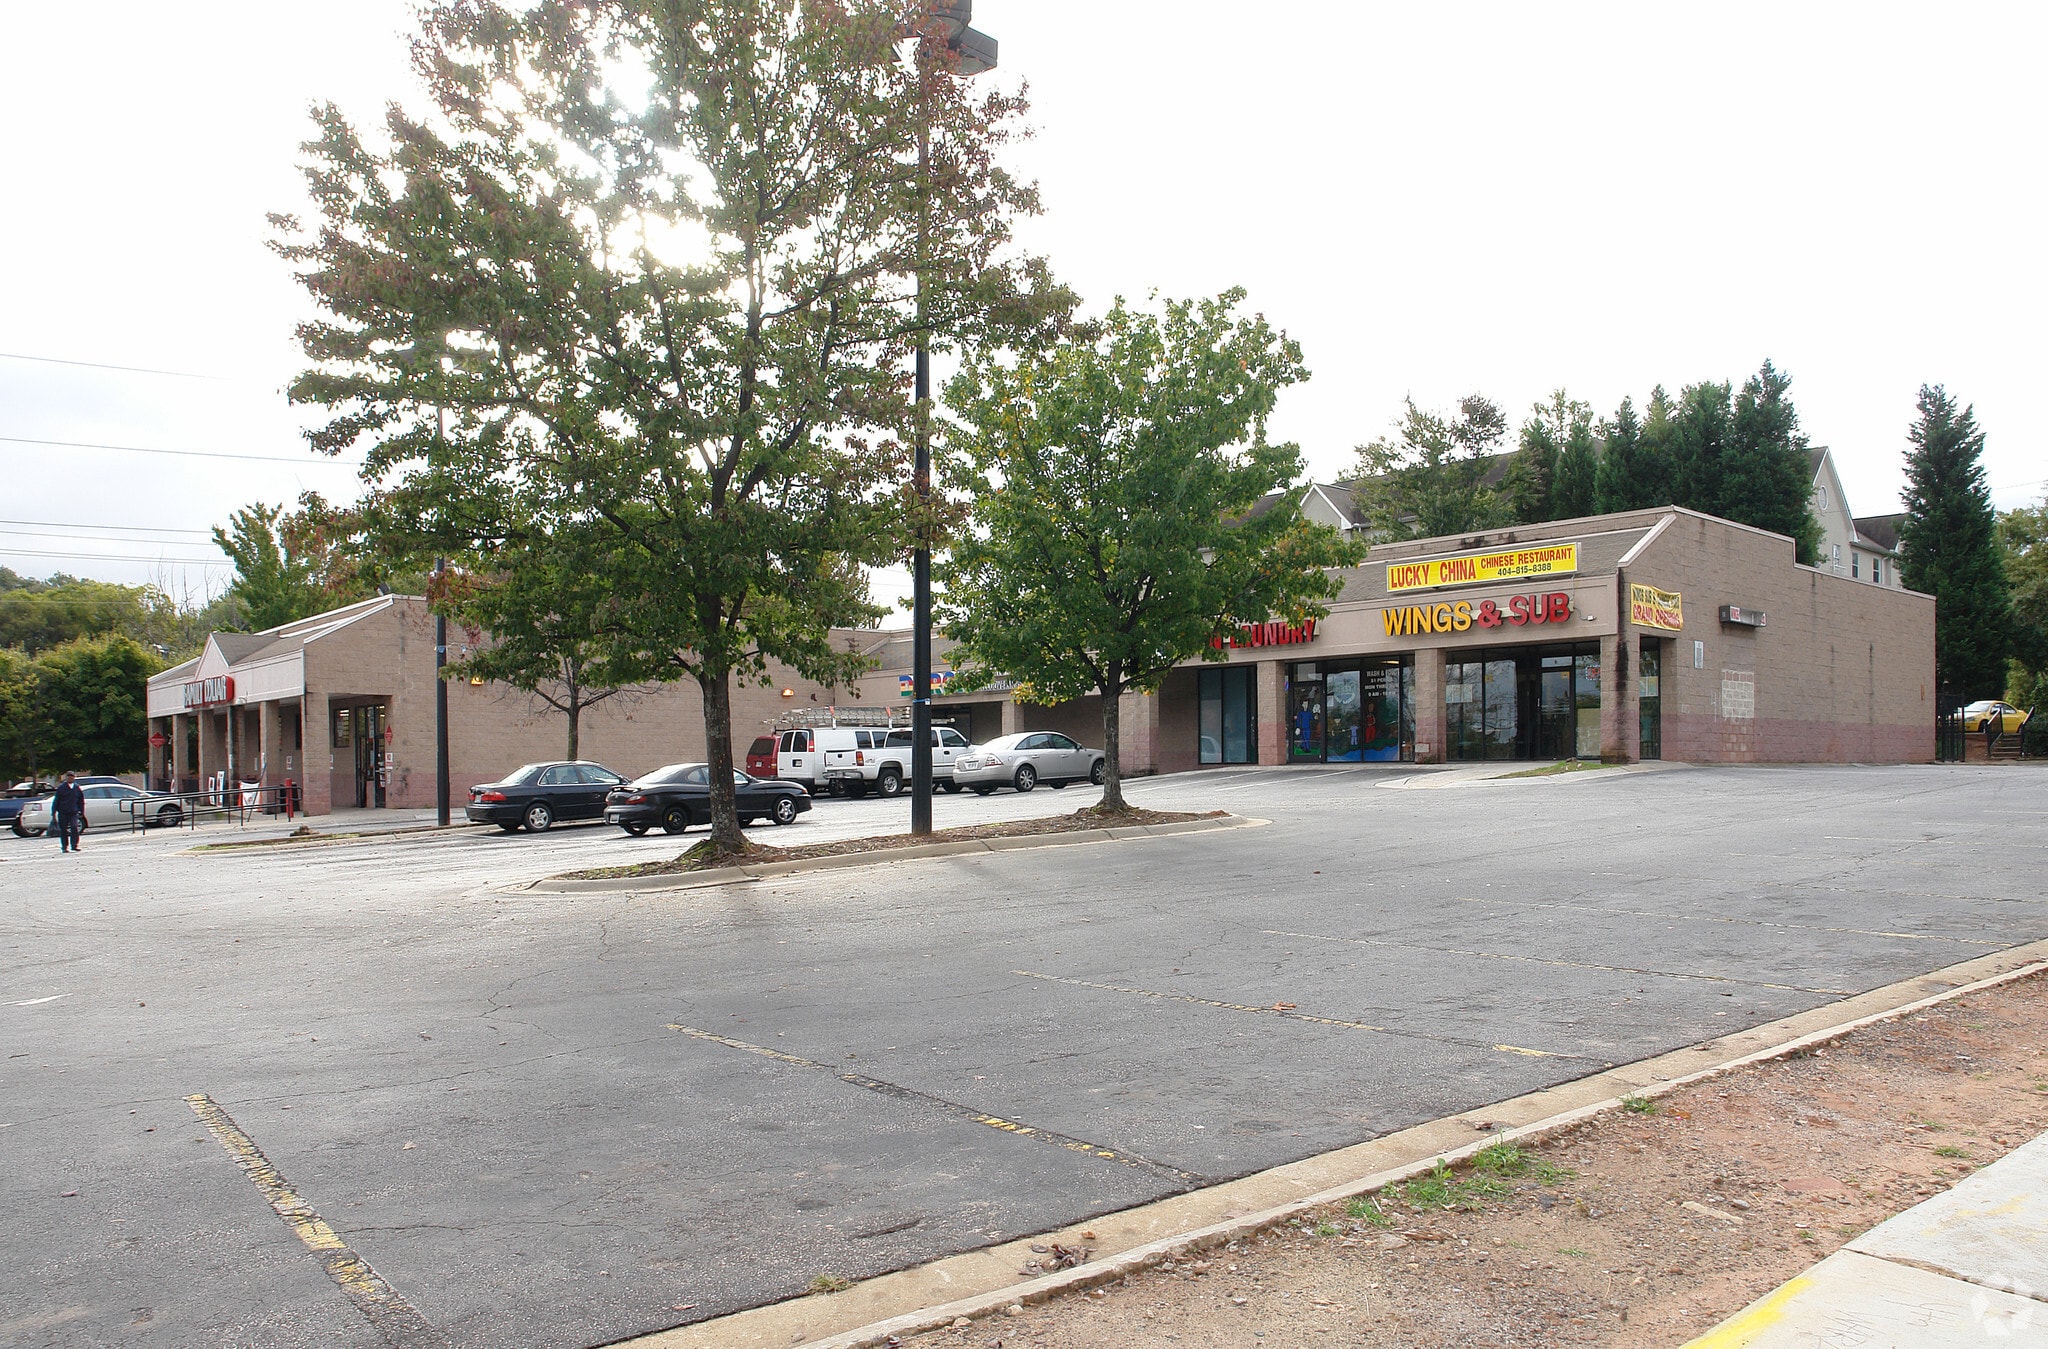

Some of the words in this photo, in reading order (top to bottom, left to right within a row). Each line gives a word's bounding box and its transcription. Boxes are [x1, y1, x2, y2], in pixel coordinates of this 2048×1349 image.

[1480, 554, 1515, 570] CHINESE
[1518, 547, 1573, 565] RESTAURANT
[1497, 562, 1552, 577] 404-815-8388
[1390, 564, 1430, 588] LUCKY
[1439, 558, 1477, 583] CHINA
[1381, 600, 1473, 637] WINGS
[1477, 599, 1503, 629] &
[1508, 592, 1572, 627] SUB
[204, 676, 227, 703] DOLLAR
